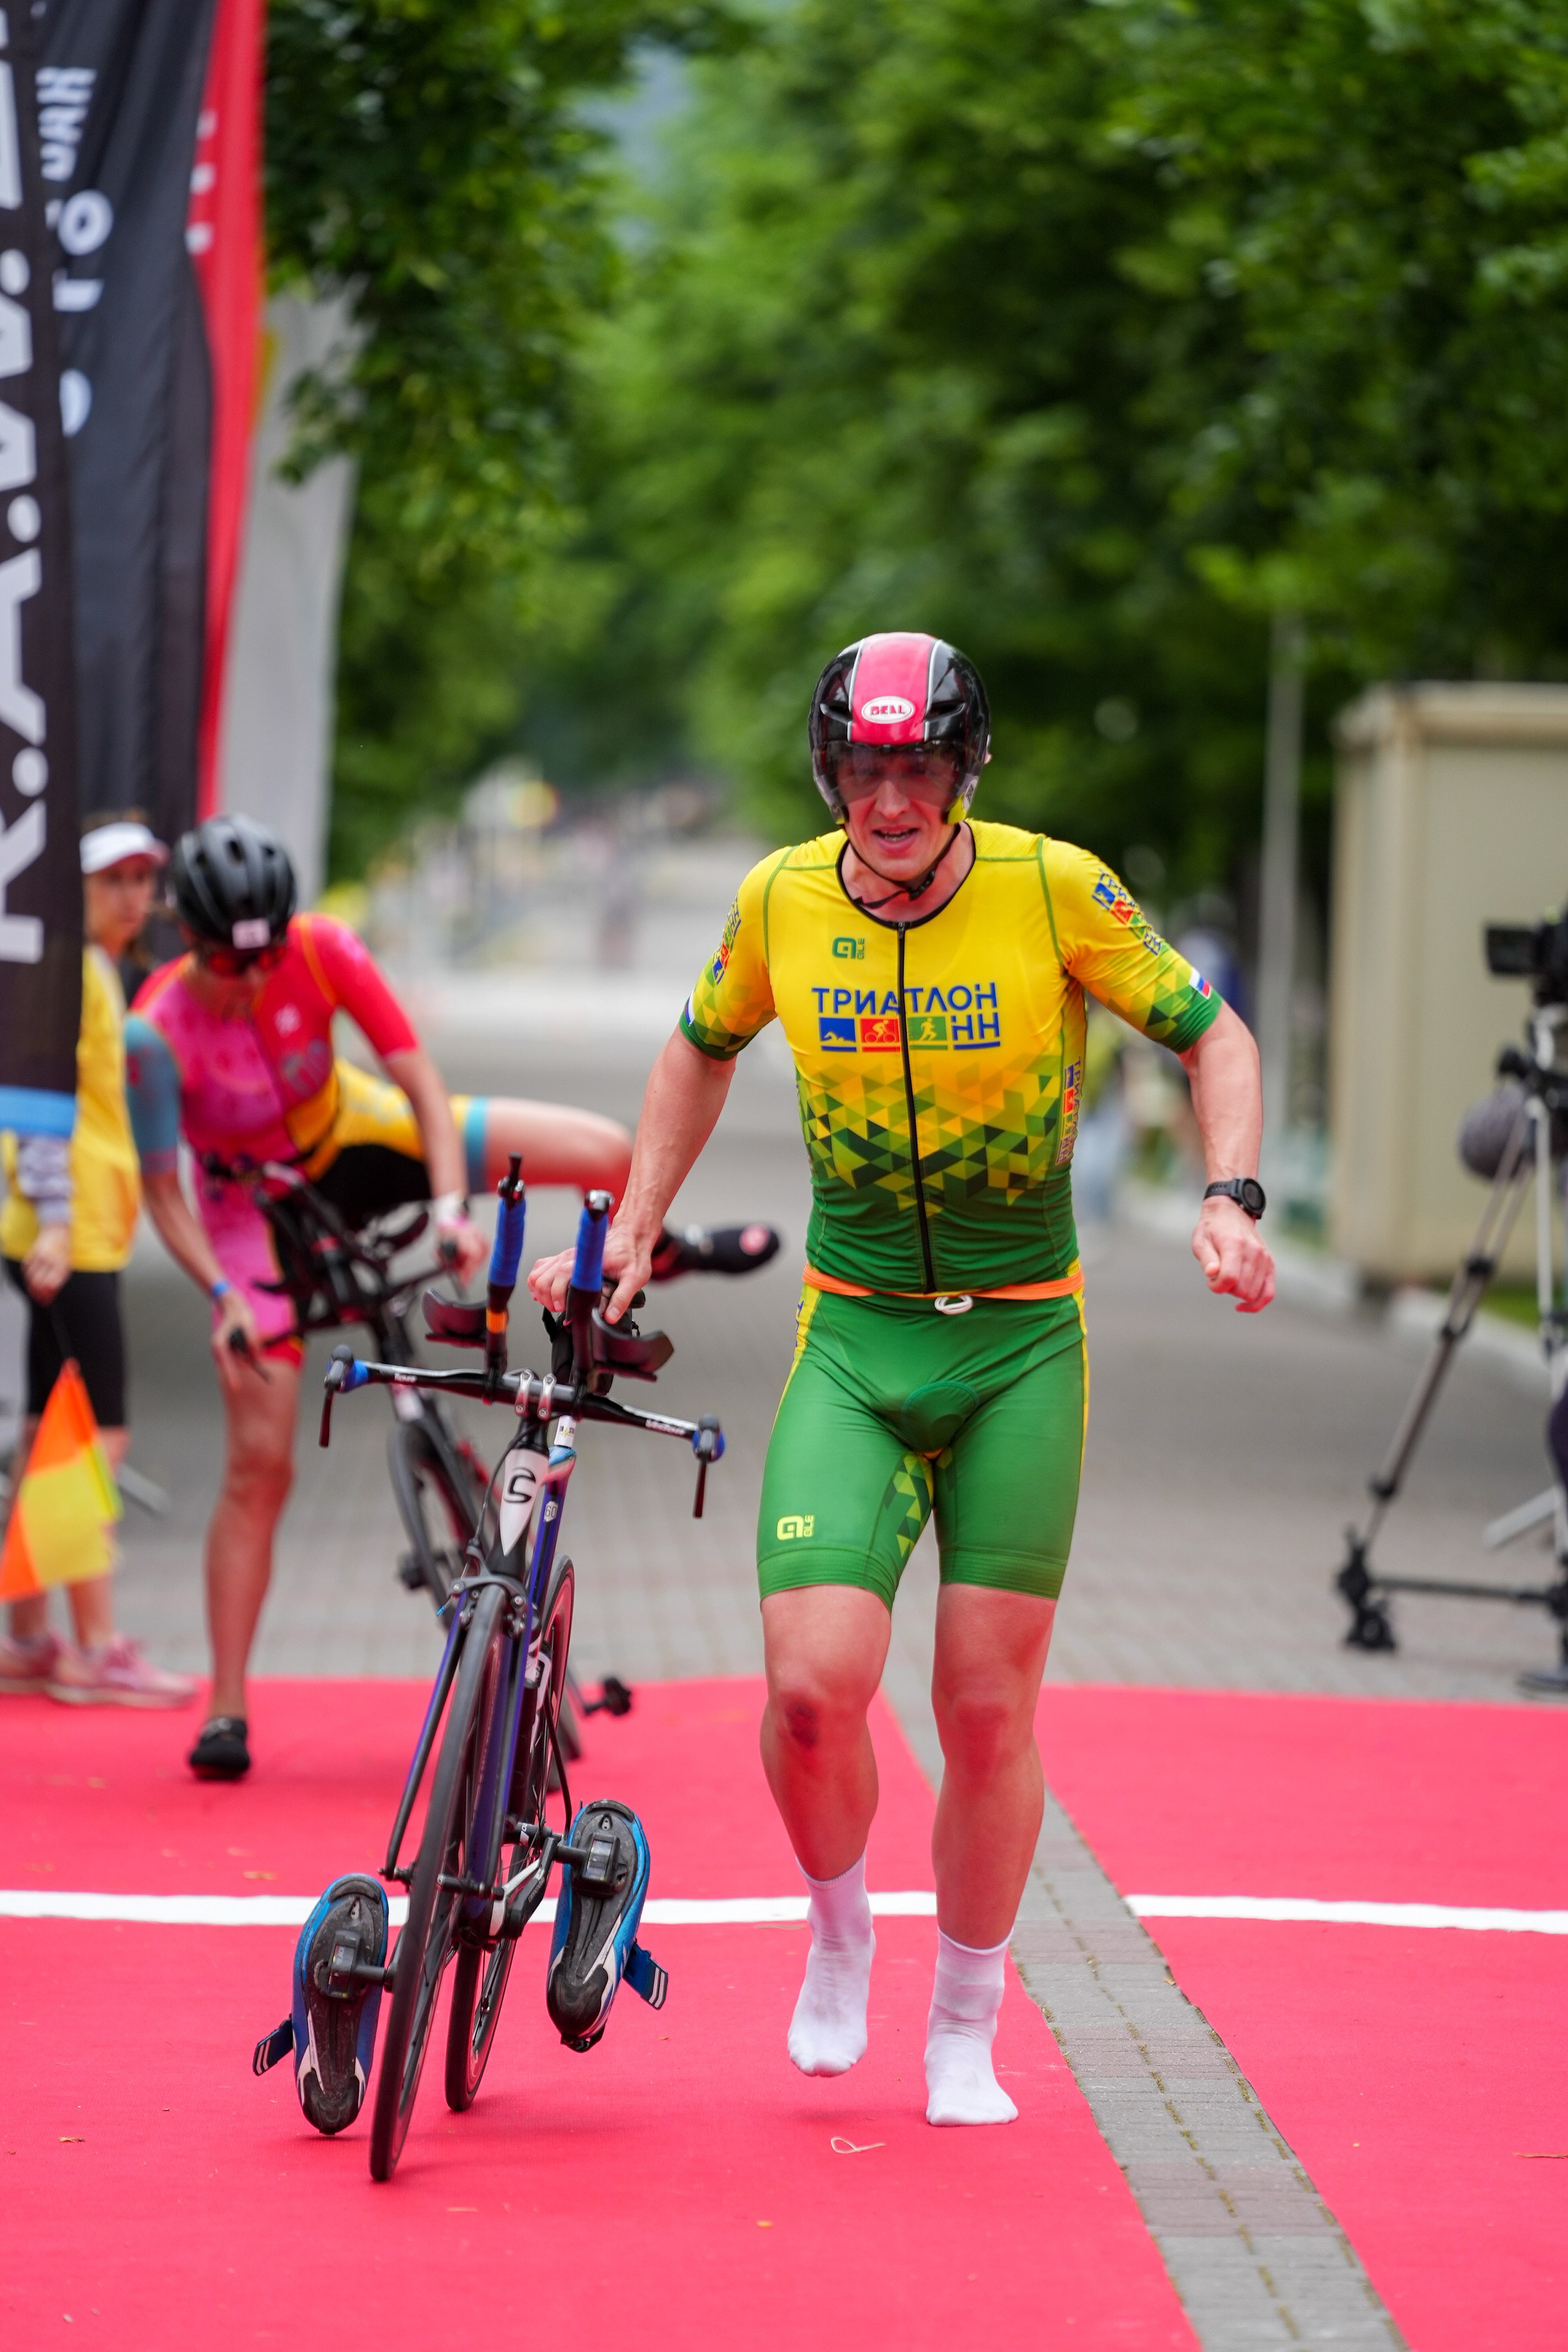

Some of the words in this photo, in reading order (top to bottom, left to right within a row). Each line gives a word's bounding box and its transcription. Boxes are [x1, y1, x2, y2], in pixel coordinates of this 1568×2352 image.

[811, 982, 998, 1015] ТРИАТЛОН
[950, 1012, 1001, 1041] НН
[545, 1505, 557, 1518] 60
